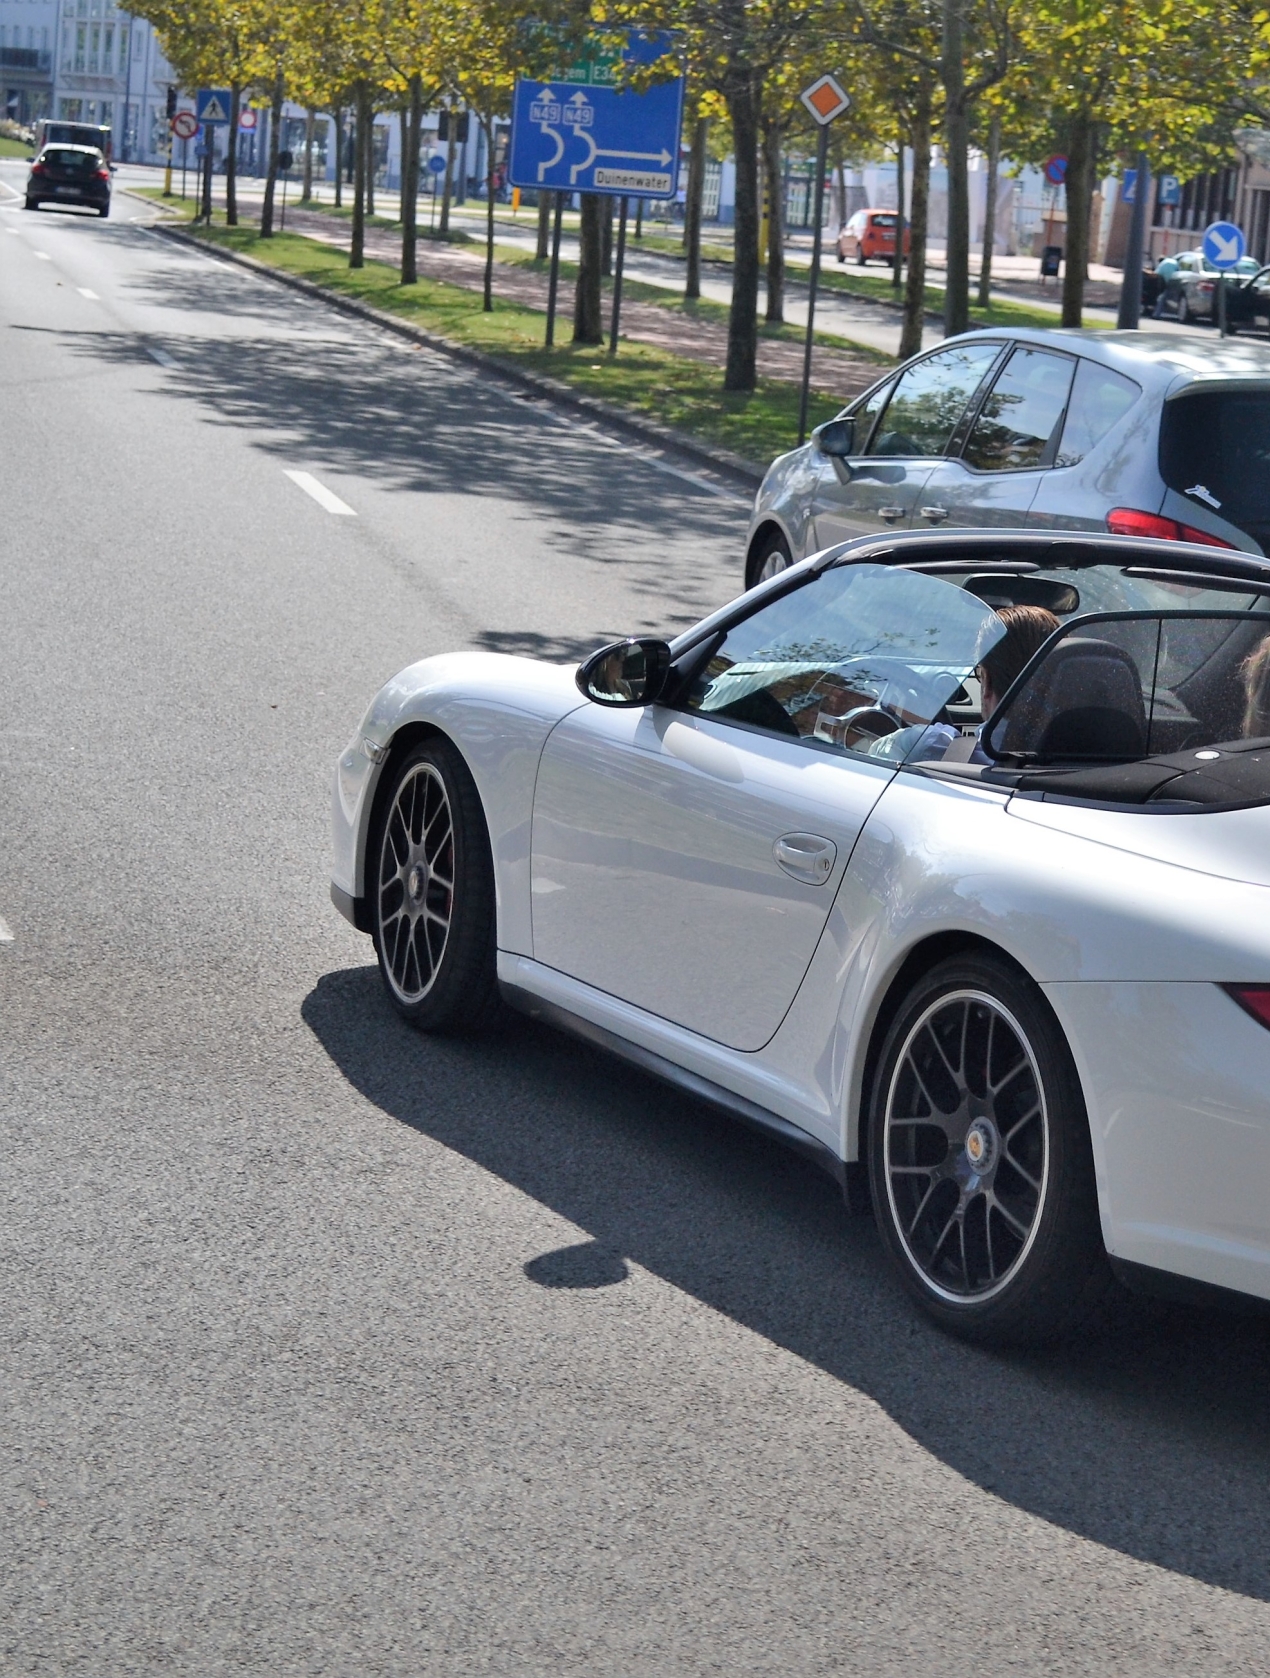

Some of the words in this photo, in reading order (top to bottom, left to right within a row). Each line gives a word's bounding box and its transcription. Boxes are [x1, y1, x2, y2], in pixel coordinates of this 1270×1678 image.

[533, 106, 558, 120] N49
[566, 109, 590, 123] N49
[597, 170, 668, 189] Duinenwater
[1161, 177, 1177, 198] P
